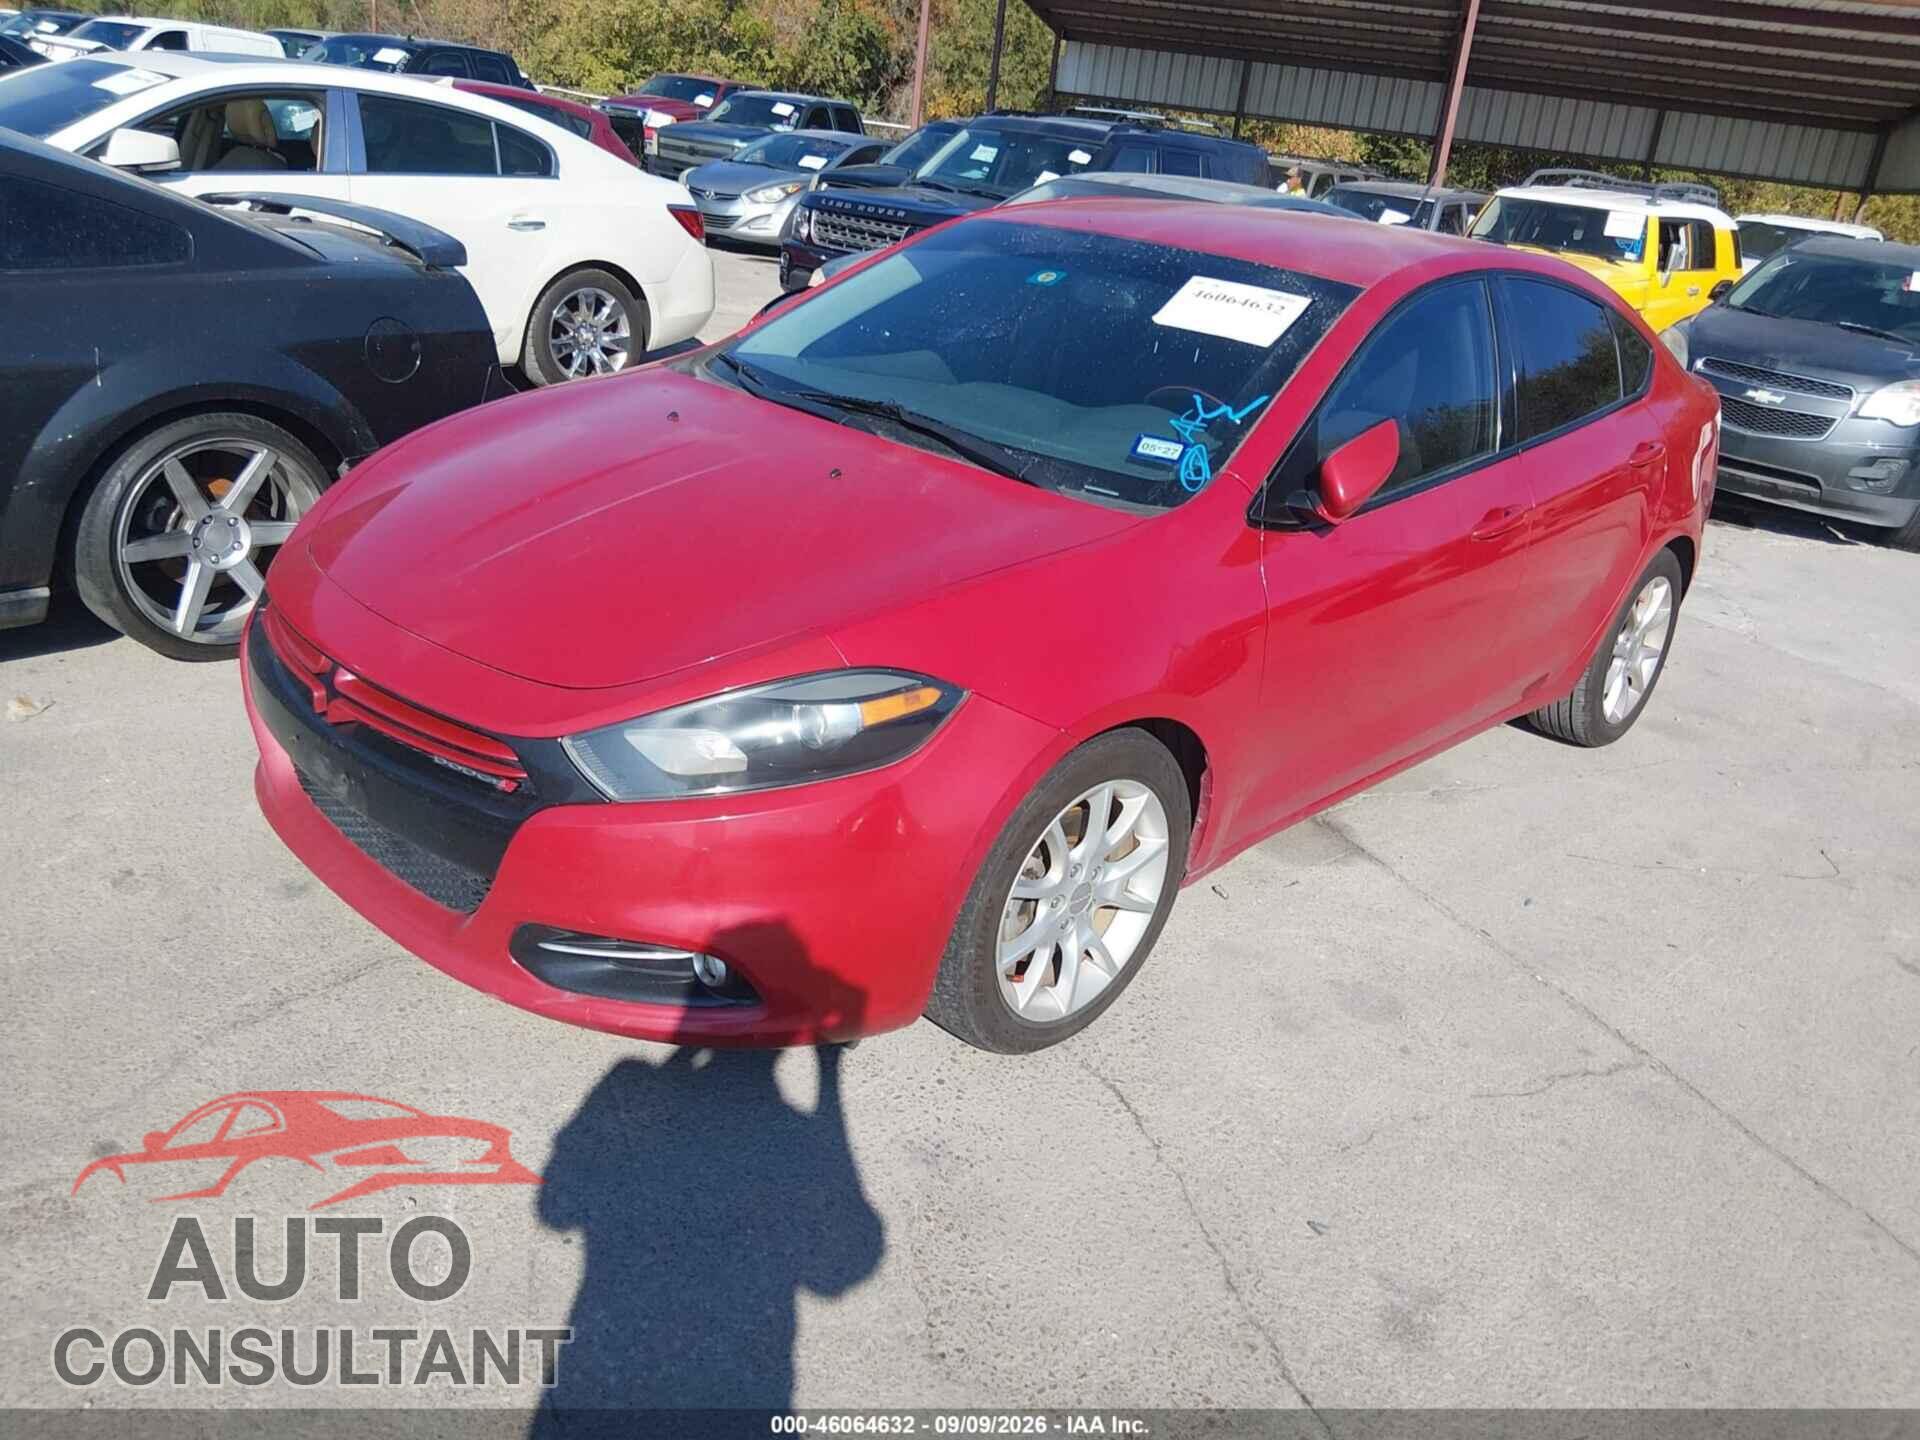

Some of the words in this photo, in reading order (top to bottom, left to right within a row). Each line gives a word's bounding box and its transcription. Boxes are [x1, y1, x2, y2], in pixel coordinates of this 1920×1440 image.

[821, 198, 852, 209] LAND
[857, 205, 907, 218] ROVER
[1192, 289, 1286, 315] 46064632
